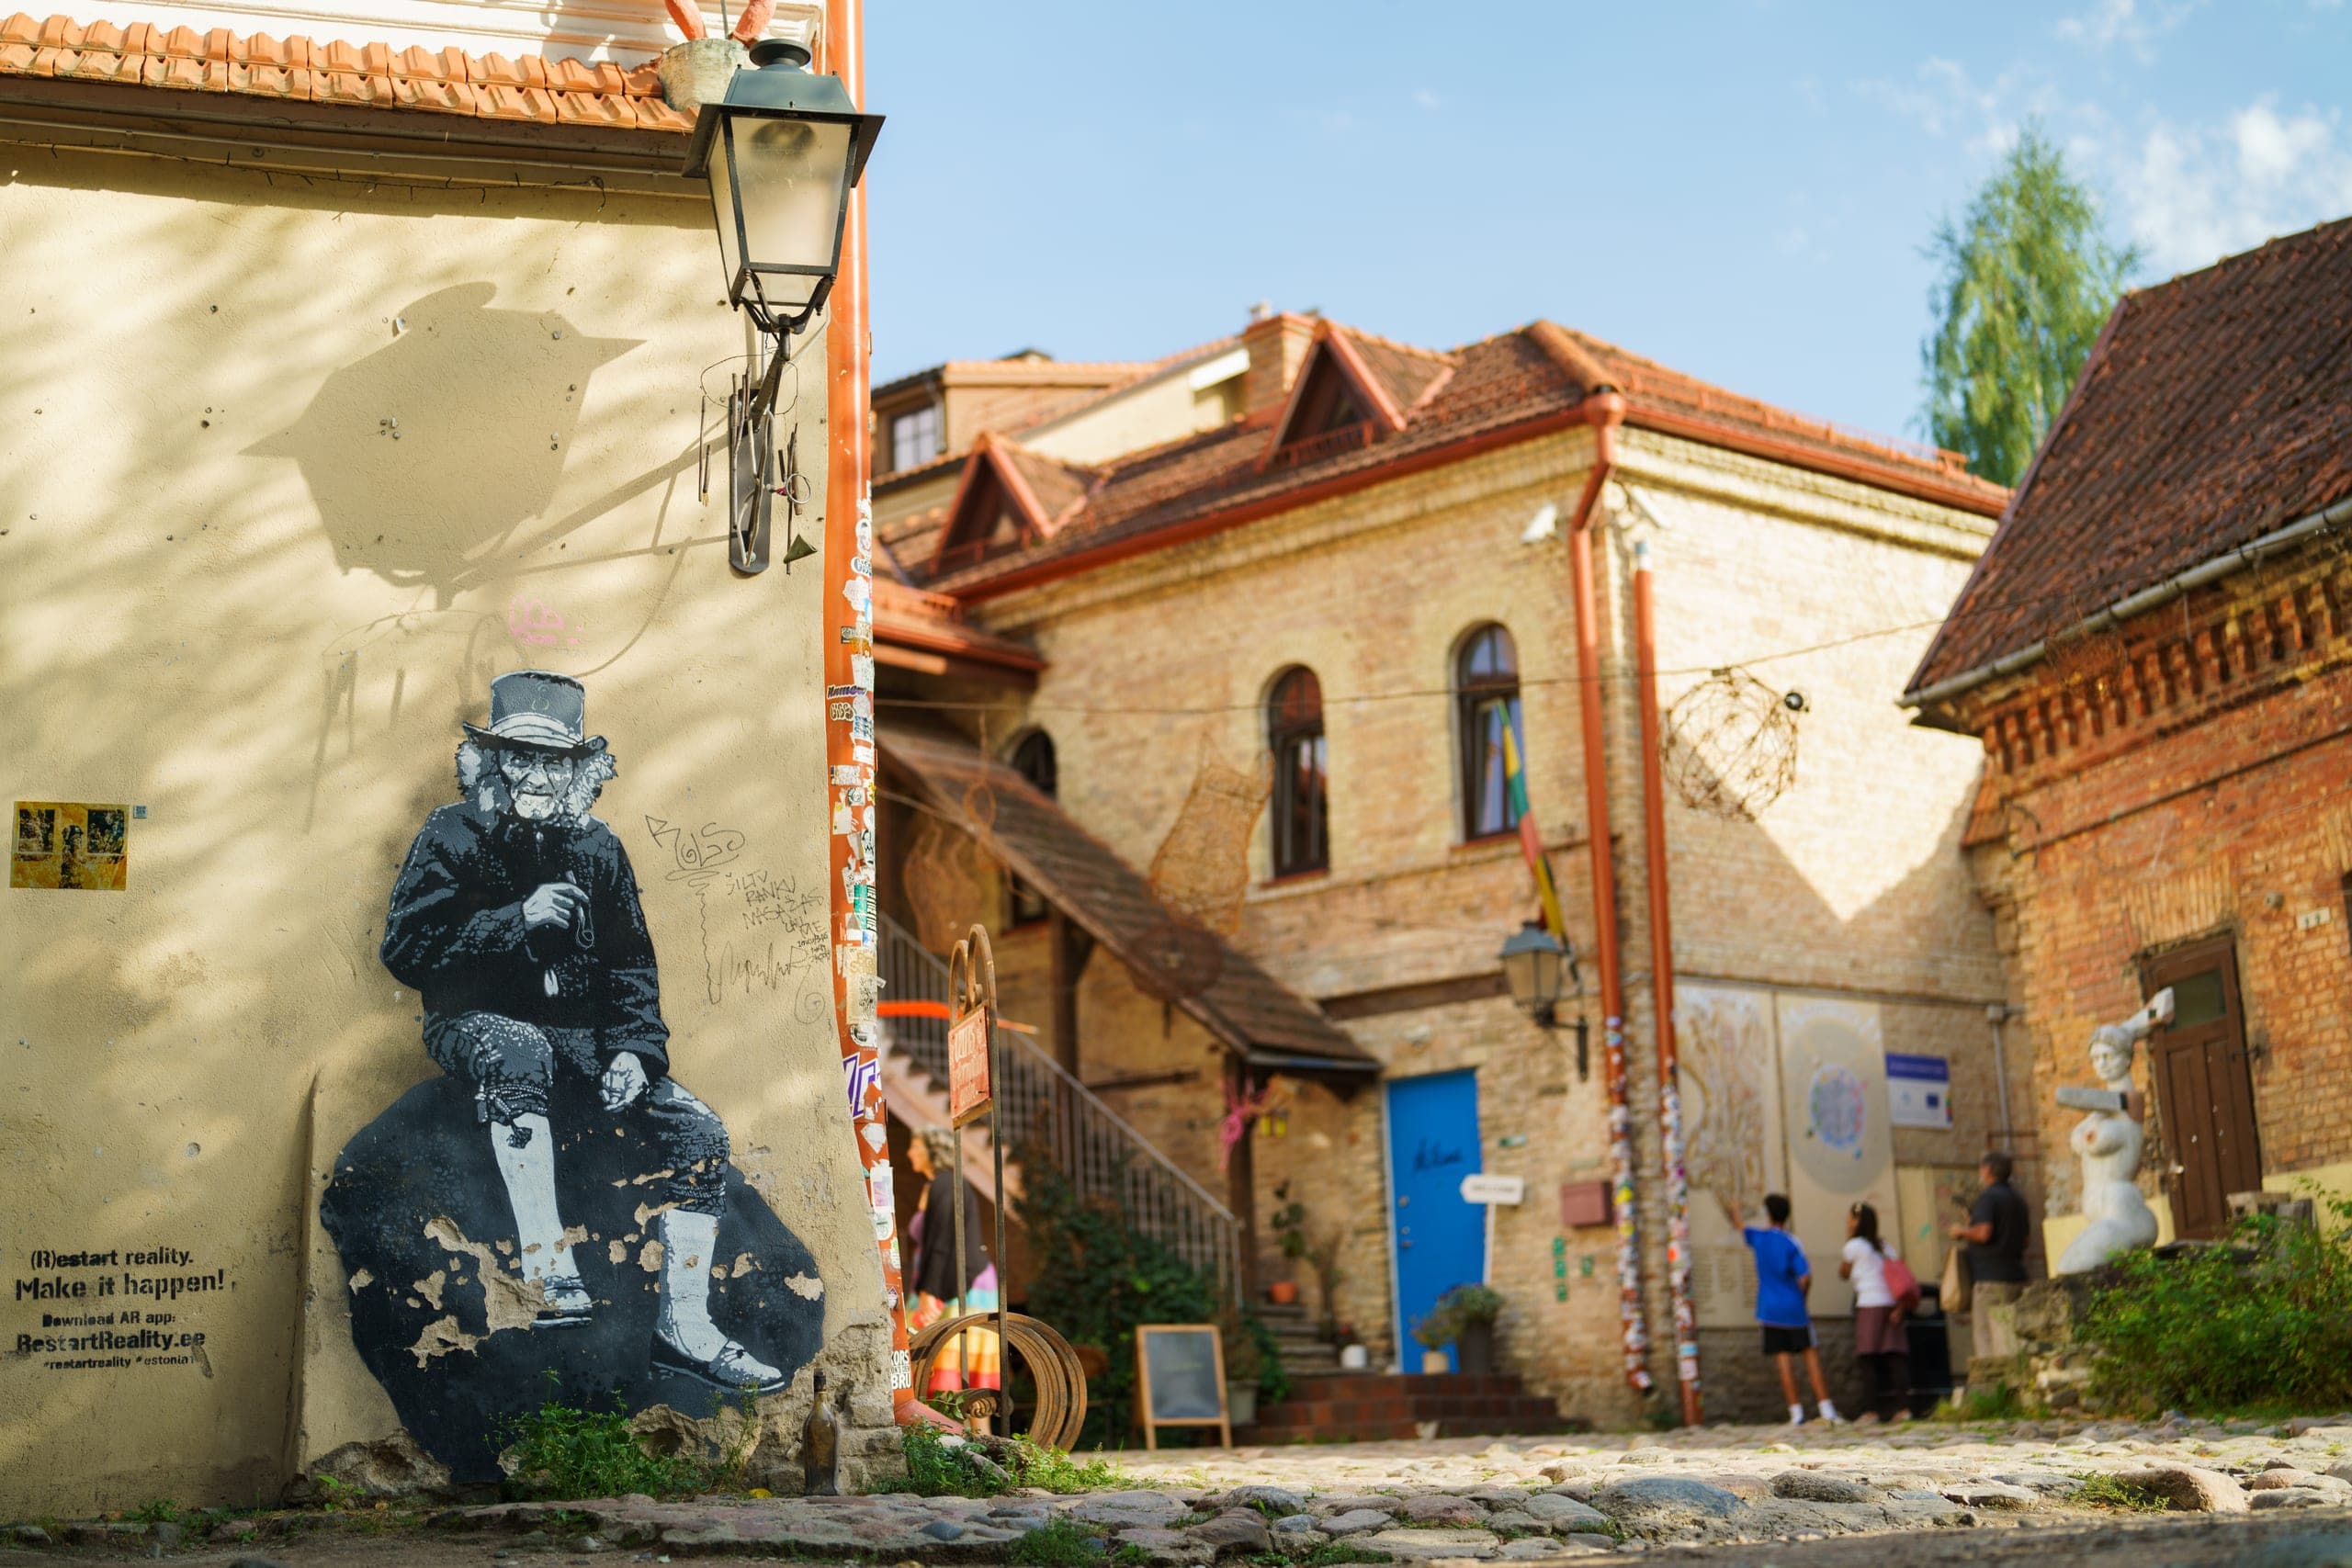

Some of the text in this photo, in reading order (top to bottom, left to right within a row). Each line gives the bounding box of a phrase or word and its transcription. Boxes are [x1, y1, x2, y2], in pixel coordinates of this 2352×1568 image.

[30, 1247, 194, 1270] (R)estart reality.
[16, 1269, 224, 1301] Make it happen!
[42, 1311, 176, 1327] Download AR app:
